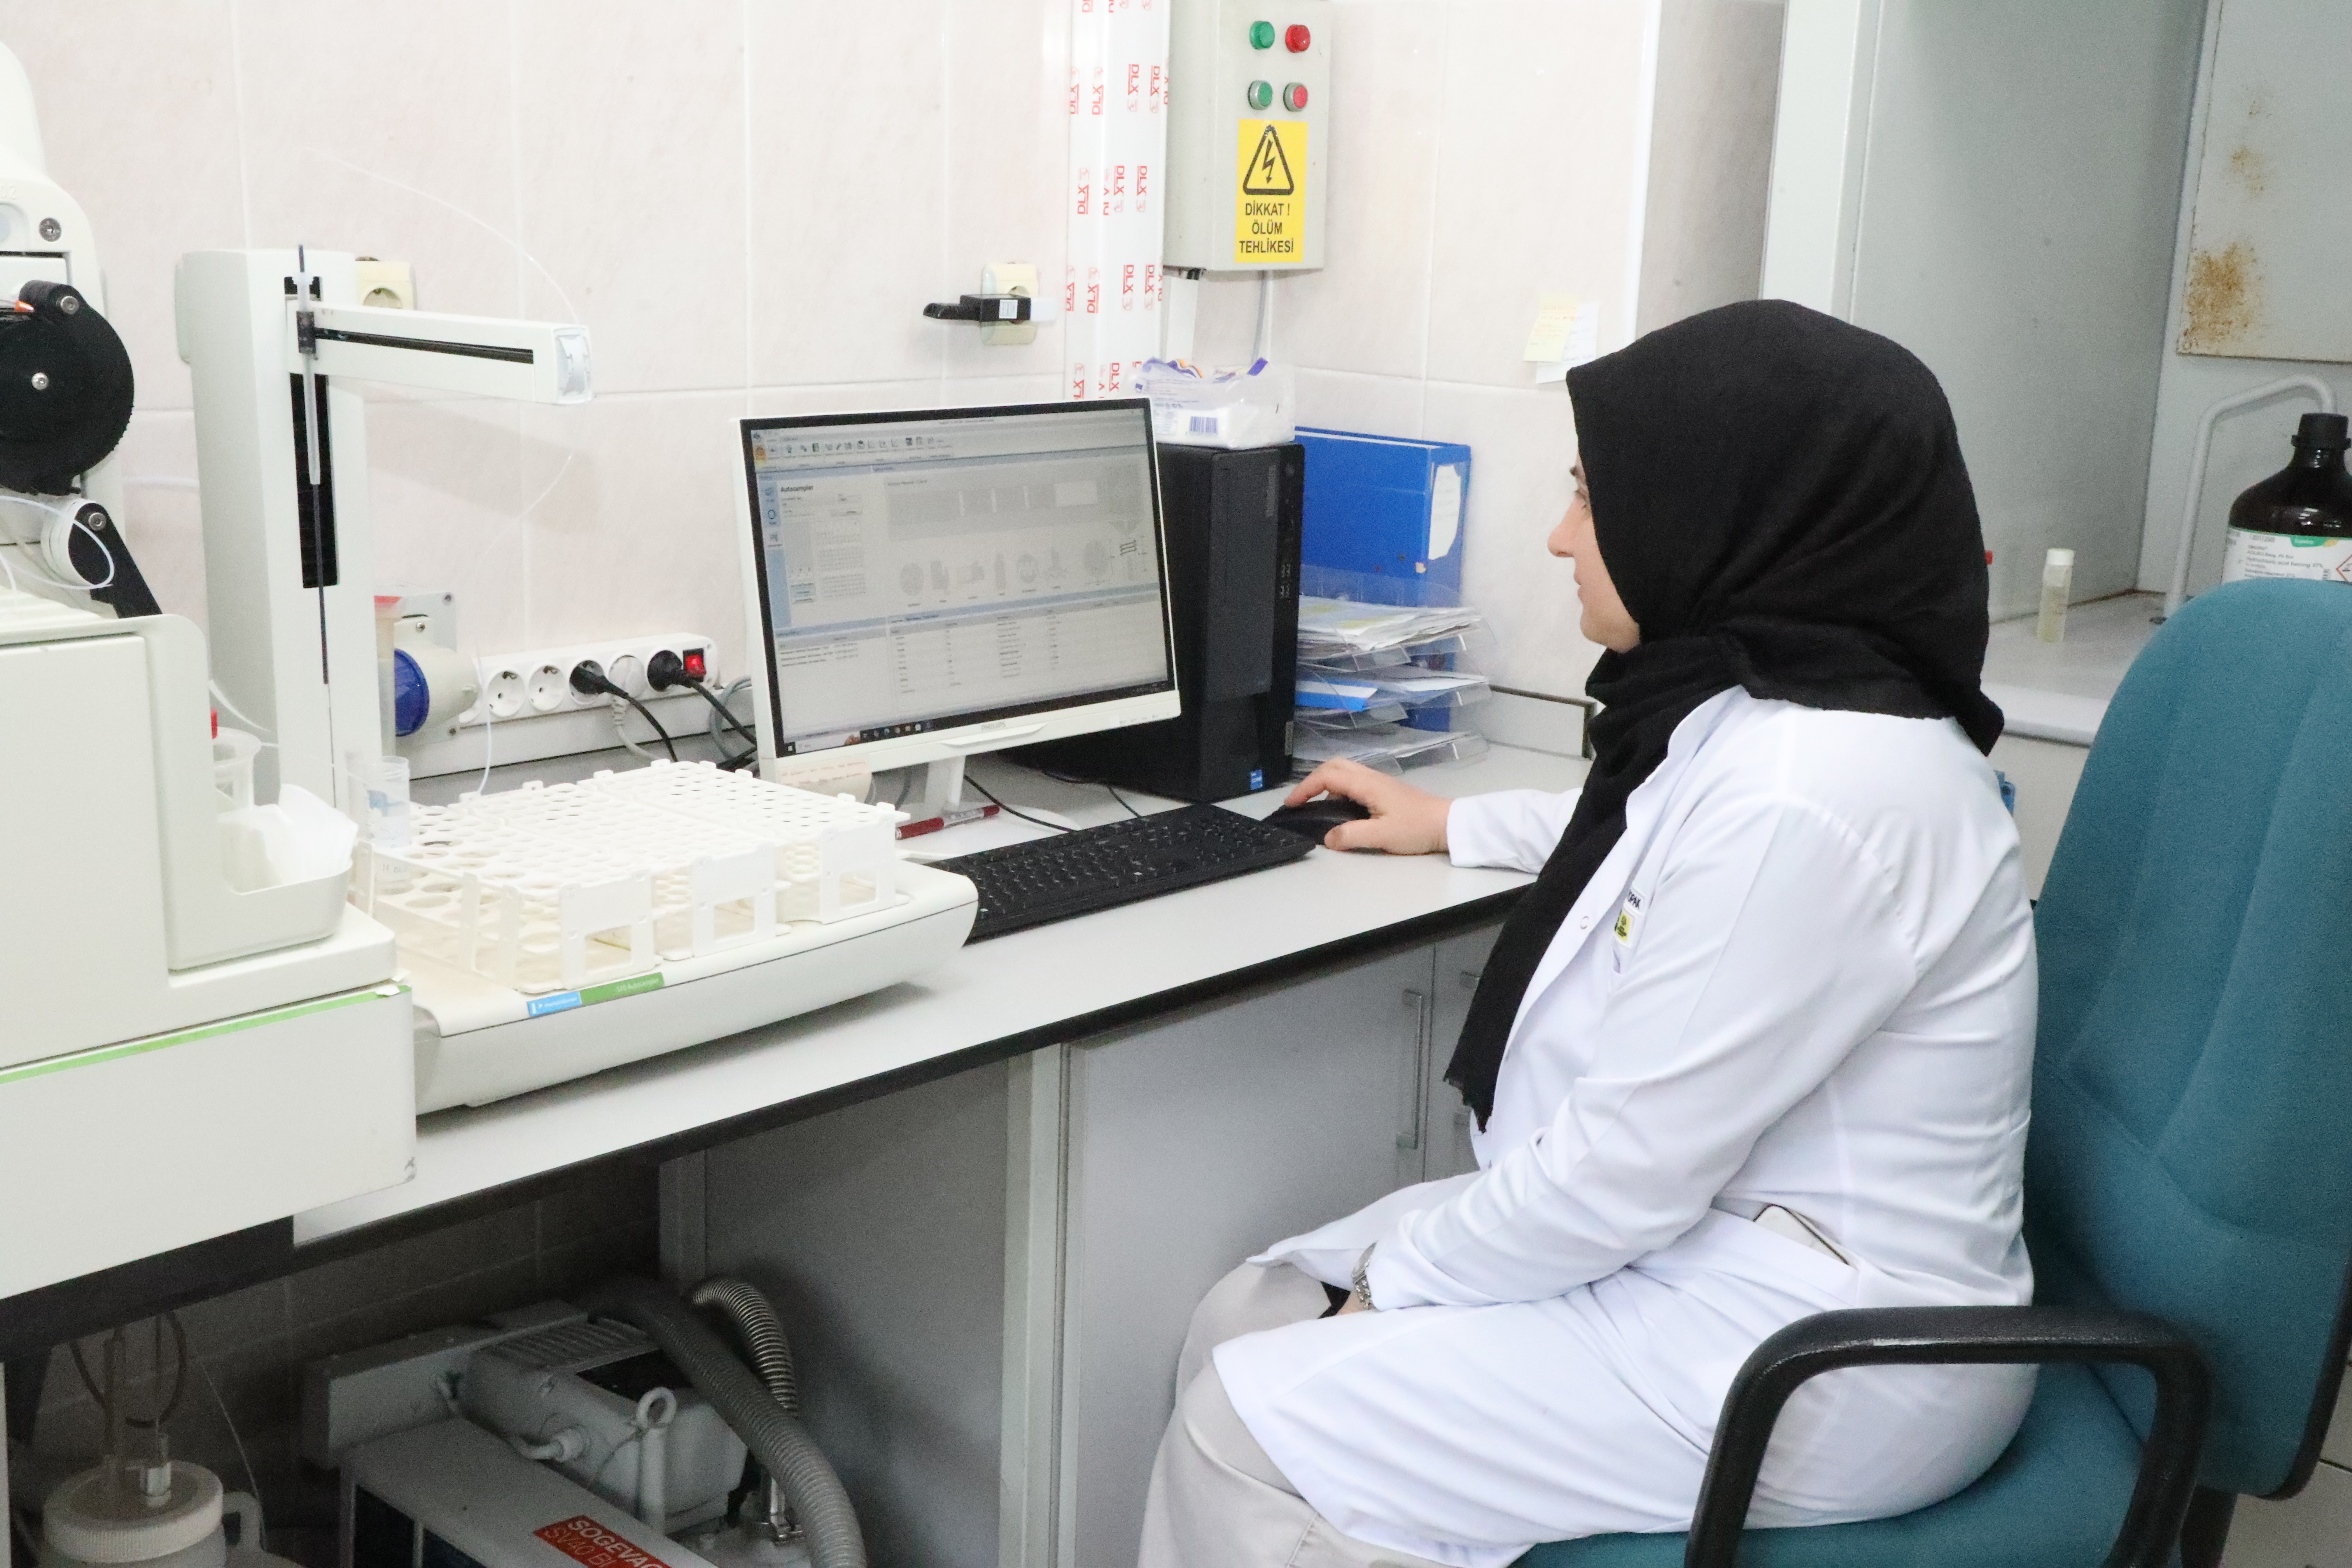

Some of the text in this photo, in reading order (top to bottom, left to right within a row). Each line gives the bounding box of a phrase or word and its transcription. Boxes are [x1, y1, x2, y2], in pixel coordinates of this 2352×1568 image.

[1128, 64, 1139, 95] DLX
[1150, 66, 1160, 96] DLX
[1092, 84, 1104, 115] DLX
[1114, 166, 1124, 195] DLX
[1137, 166, 1147, 196] DLX
[1078, 184, 1089, 214] DLX
[1245, 200, 1284, 216] DİKKAT
[1252, 219, 1283, 235] ÖLÜM
[1239, 237, 1294, 253] TEHLİKESİ
[1123, 265, 1134, 294] DLX
[1145, 265, 1154, 294] DLX
[1087, 284, 1099, 313] DLX
[1109, 363, 1120, 392] DLX
[981, 721, 1006, 731] PHILIPS
